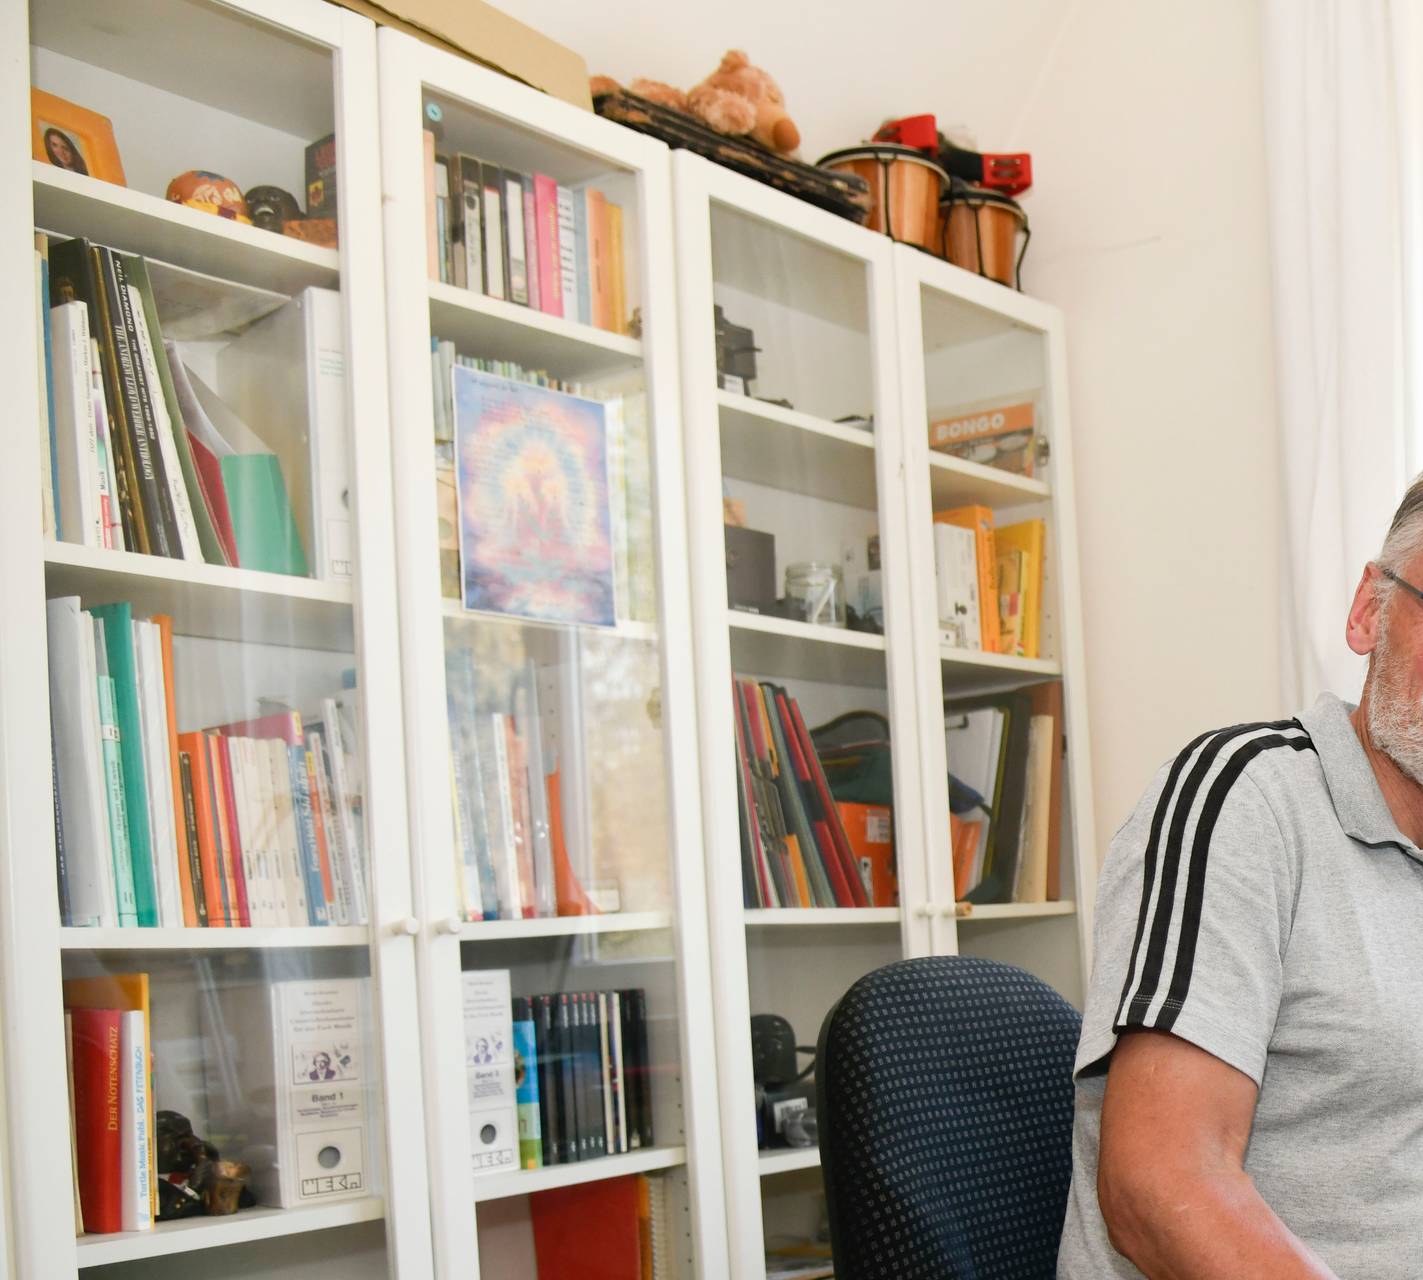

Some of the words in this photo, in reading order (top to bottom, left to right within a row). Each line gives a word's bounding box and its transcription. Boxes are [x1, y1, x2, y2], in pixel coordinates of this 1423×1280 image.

[114, 259, 124, 283] NEIL
[120, 284, 135, 333] DIAMOND
[937, 413, 1005, 441] BONGO
[107, 1025, 119, 1104] NOTENSCHATZ
[311, 1092, 337, 1103] Band
[107, 1105, 118, 1131] DER
